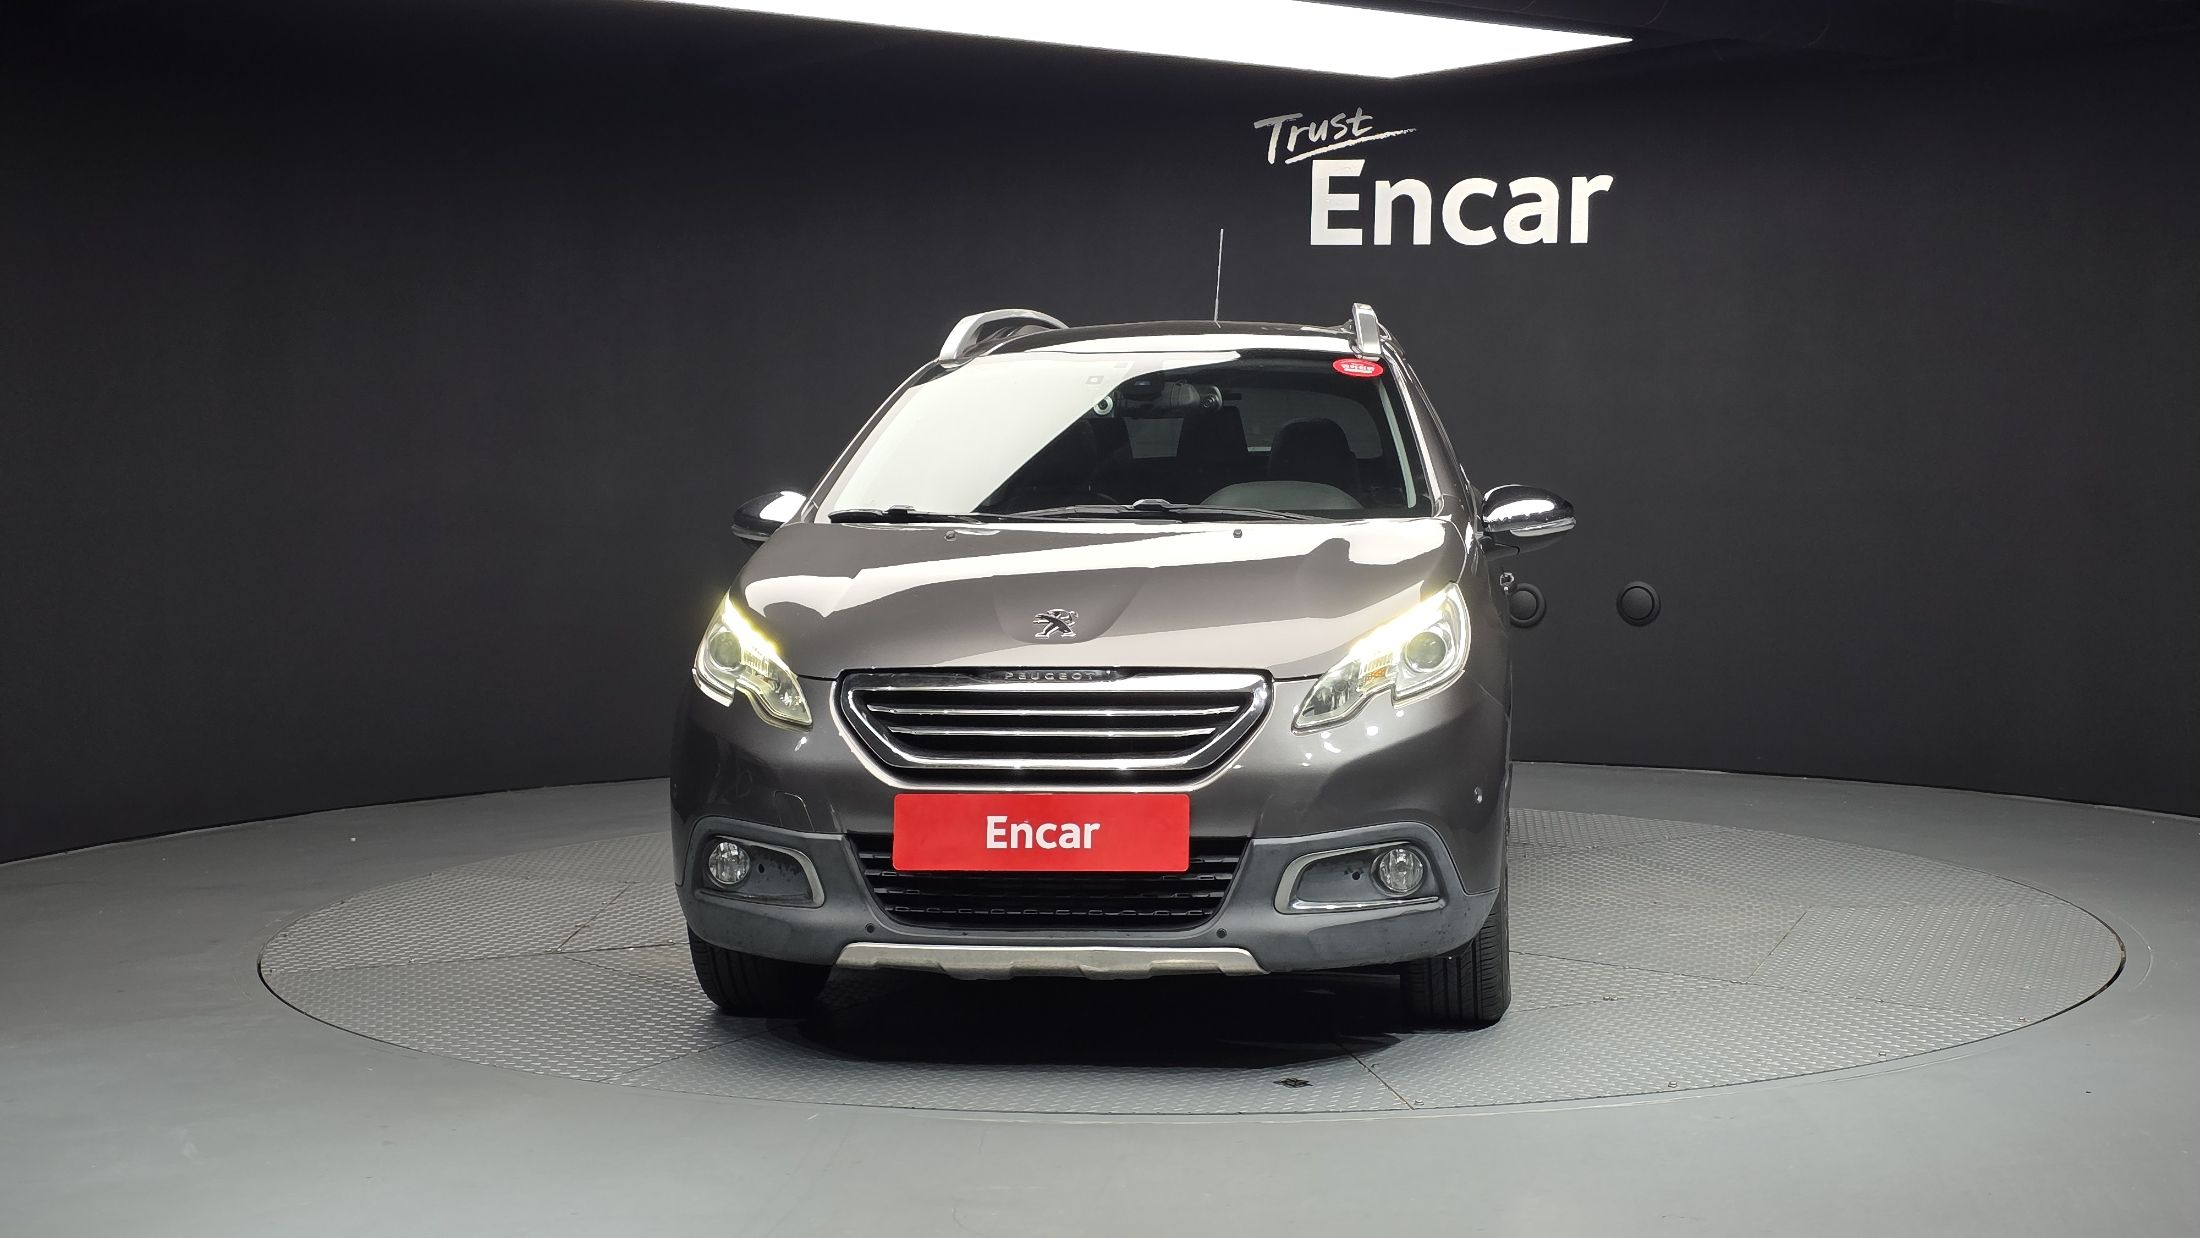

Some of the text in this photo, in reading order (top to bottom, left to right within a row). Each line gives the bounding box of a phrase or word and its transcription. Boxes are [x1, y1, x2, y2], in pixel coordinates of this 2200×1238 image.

[1253, 106, 1374, 164] Trust
[1310, 159, 1614, 246] Encar
[1004, 672, 1096, 681] PEUGEOT
[986, 815, 1101, 849] Encar
